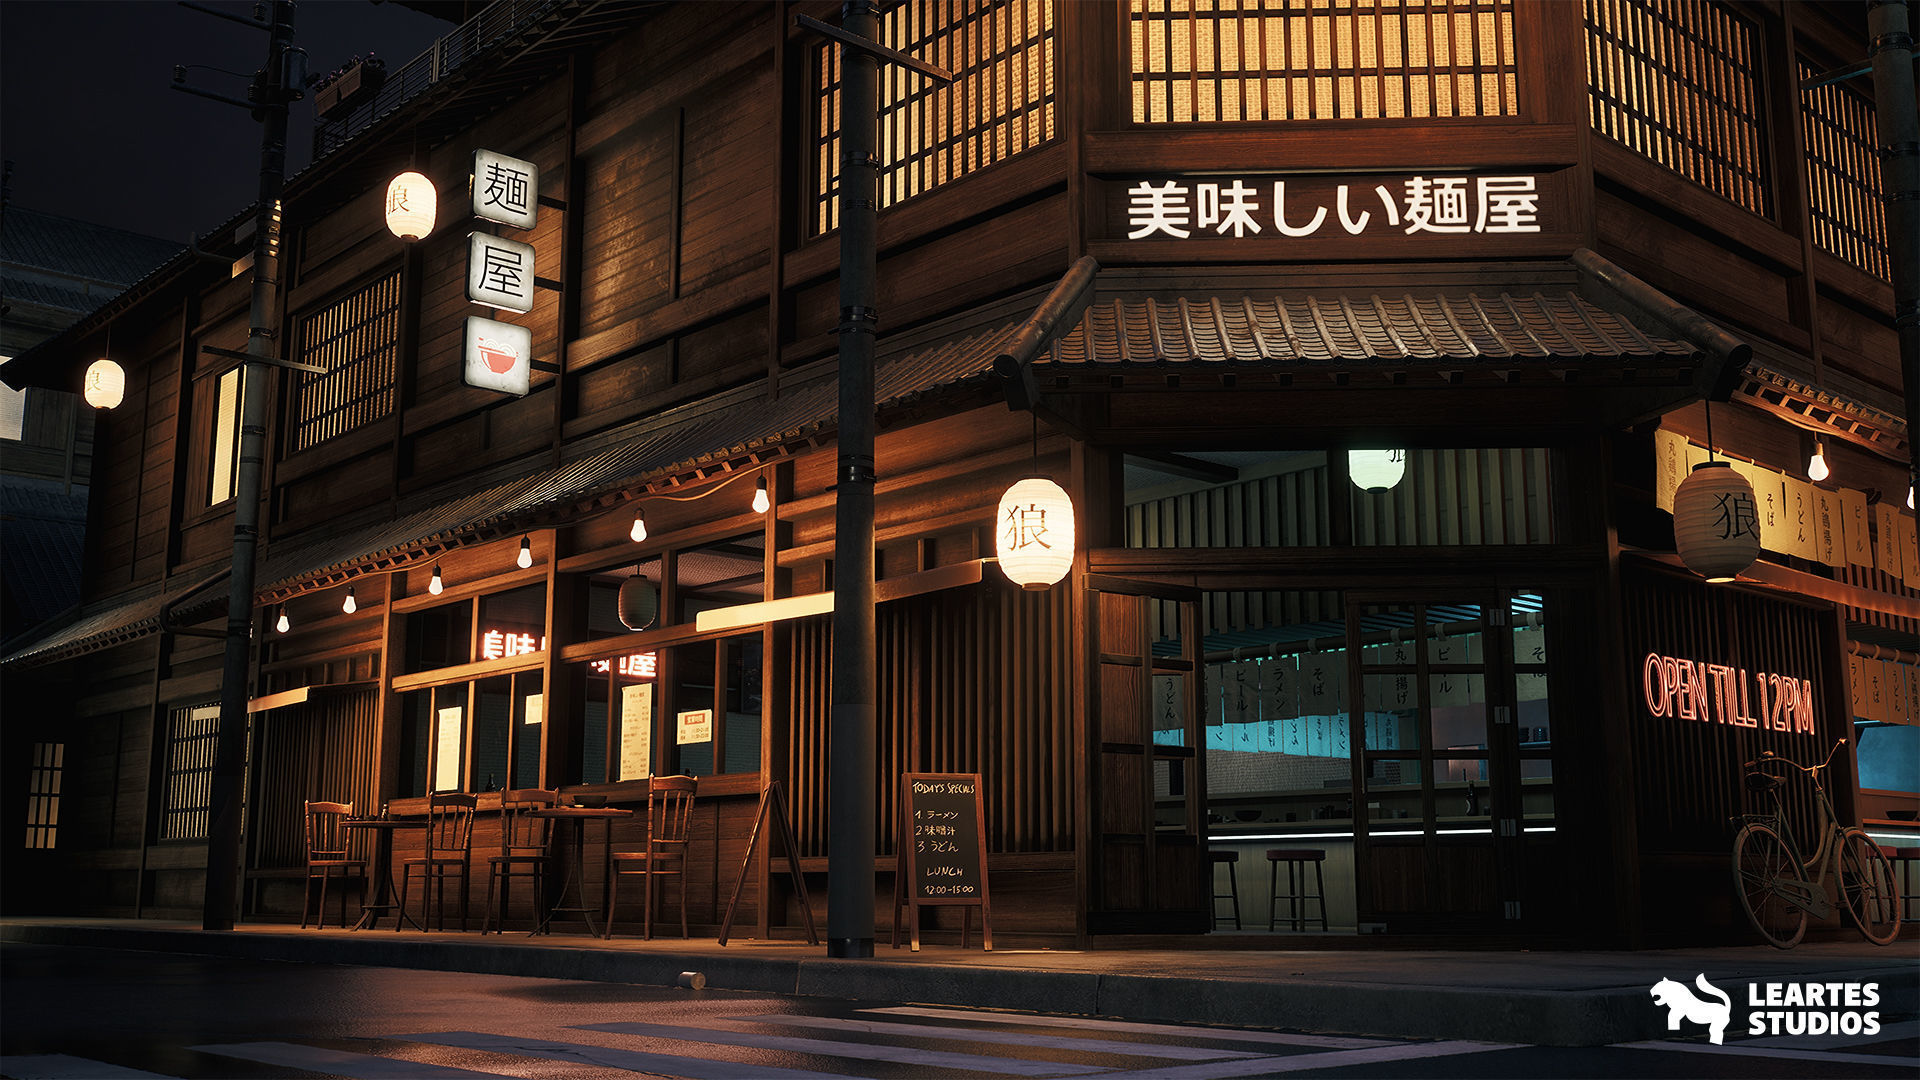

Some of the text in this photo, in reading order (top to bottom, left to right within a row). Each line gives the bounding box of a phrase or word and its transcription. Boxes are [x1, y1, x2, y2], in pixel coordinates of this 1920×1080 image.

[1127, 176, 1541, 240] 美味しい麺屋
[478, 162, 529, 298] 麺 屋
[1004, 503, 1052, 552] 狼
[1712, 492, 1758, 540] 狼
[1766, 493, 1775, 527] そば
[1854, 504, 1864, 553] ビール
[1236, 669, 1249, 712] ビール
[1273, 668, 1285, 710] ラメン
[1313, 667, 1325, 697] そば
[1394, 648, 1408, 704] 丸揚げ
[1438, 647, 1453, 693] ビル
[1165, 678, 1176, 719] うどん
[1643, 652, 1815, 735] OPEN TILL 12PM
[947, 782, 975, 794] SPECIALS
[927, 810, 959, 820] ラーメン
[931, 840, 959, 853] うどん
[926, 865, 964, 876] LUNCH
